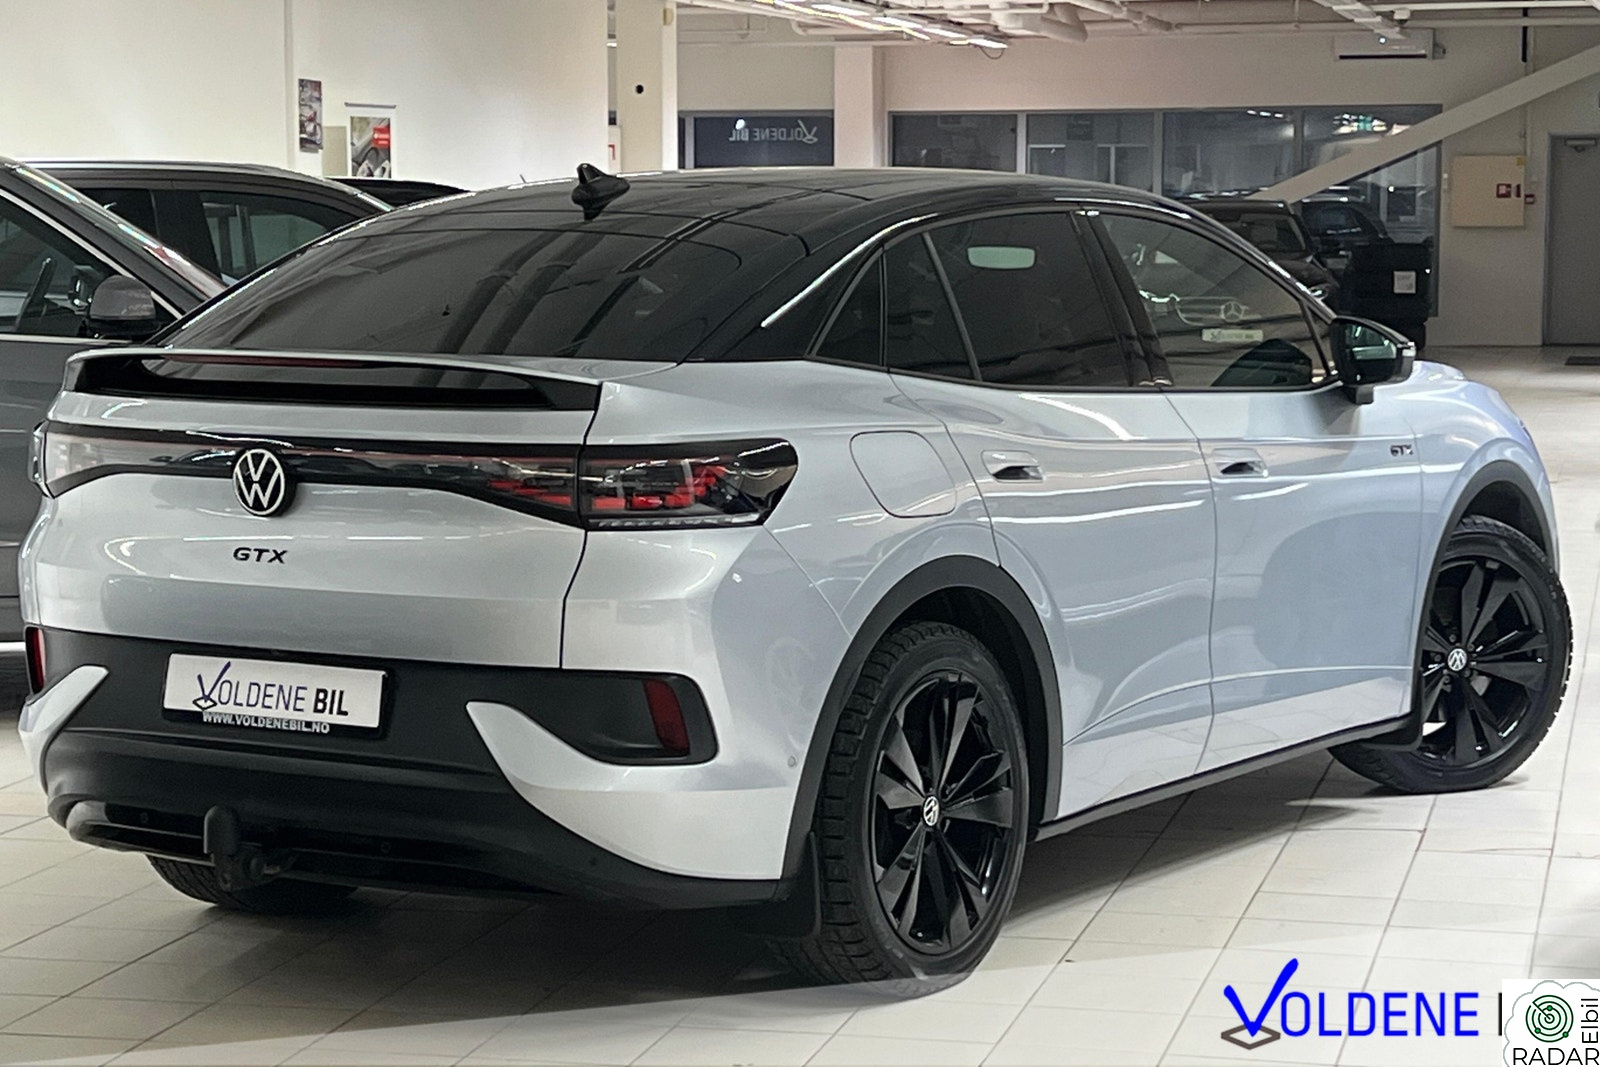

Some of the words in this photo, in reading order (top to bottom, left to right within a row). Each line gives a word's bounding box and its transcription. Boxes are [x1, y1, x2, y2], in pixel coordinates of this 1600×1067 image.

[233, 546, 288, 564] GTX
[197, 660, 308, 712] VOLDENE
[313, 688, 349, 716] BIL
[202, 710, 330, 734] WWW.VOLDENEBIL.NO
